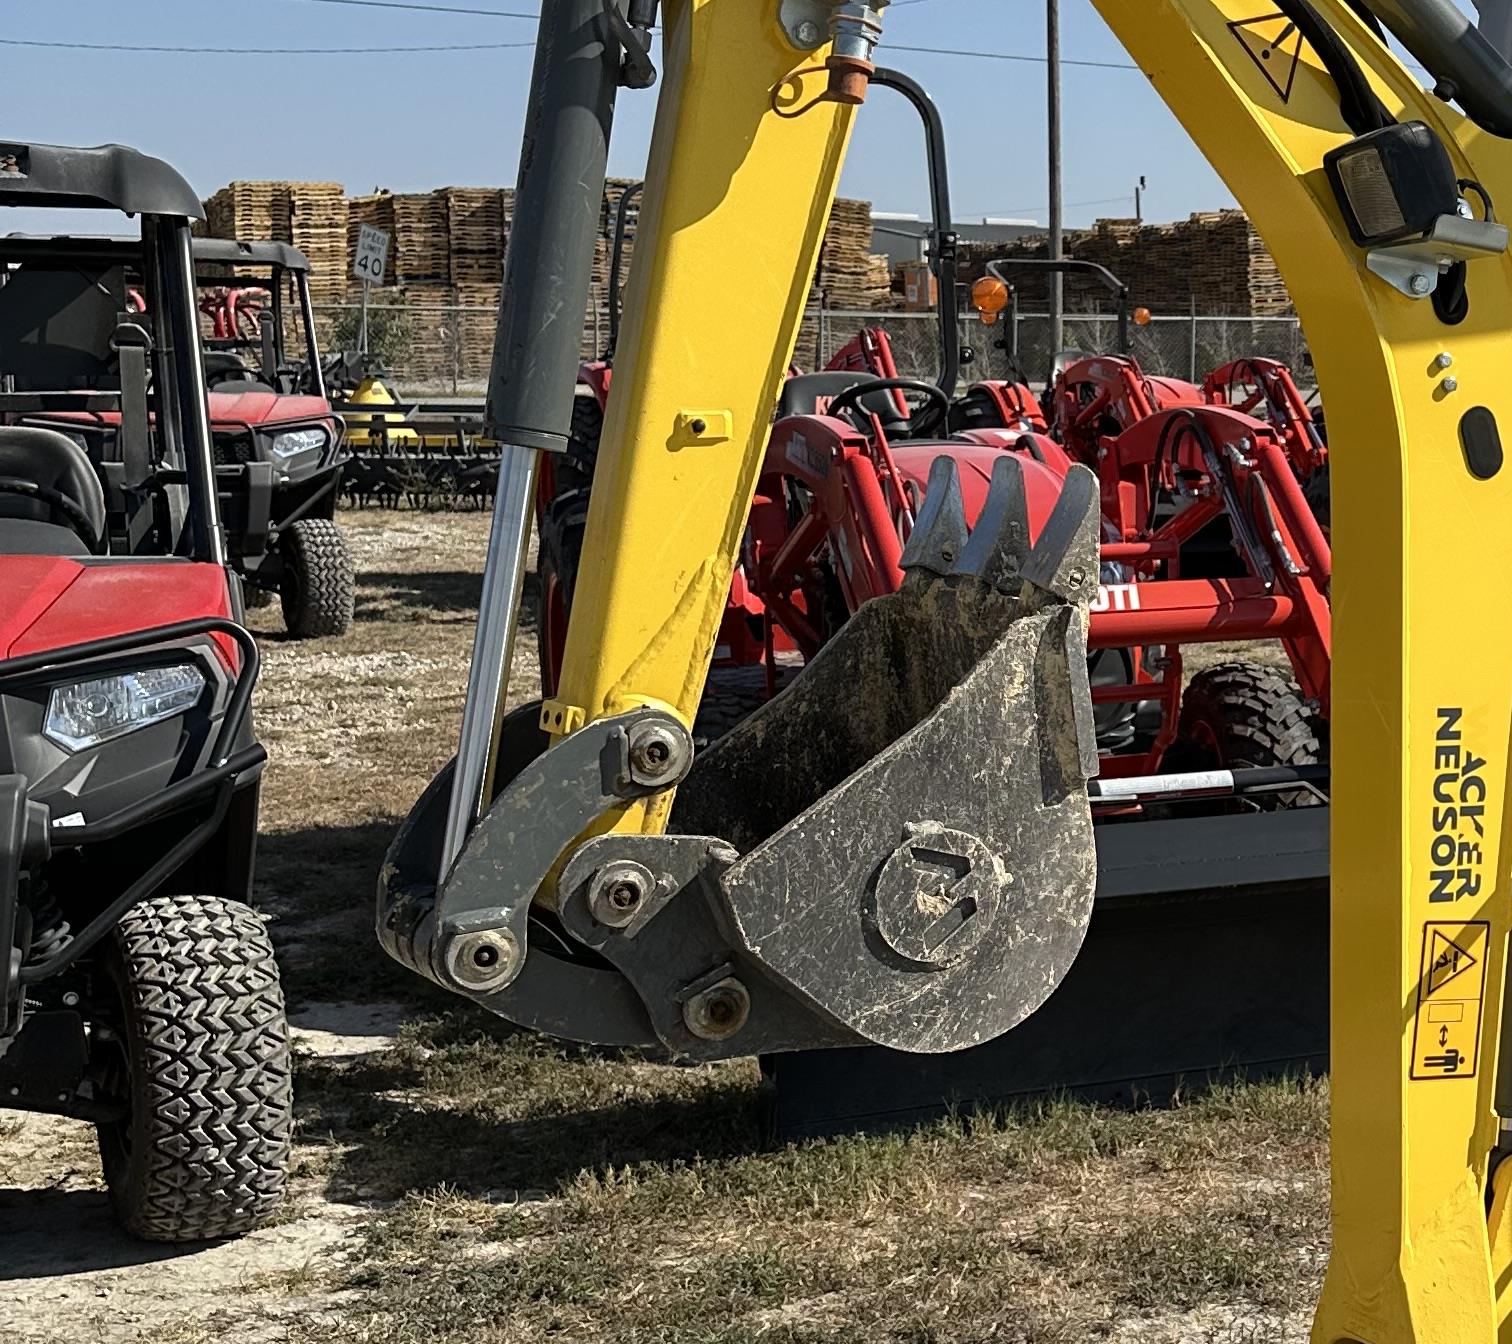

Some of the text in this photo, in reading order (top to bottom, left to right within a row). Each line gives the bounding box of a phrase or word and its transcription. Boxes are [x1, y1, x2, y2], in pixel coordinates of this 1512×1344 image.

[358, 255, 382, 276] 40
[361, 229, 386, 247] SPEED
[1428, 707, 1463, 904] NEUSON
[1456, 749, 1487, 903] ACKER
